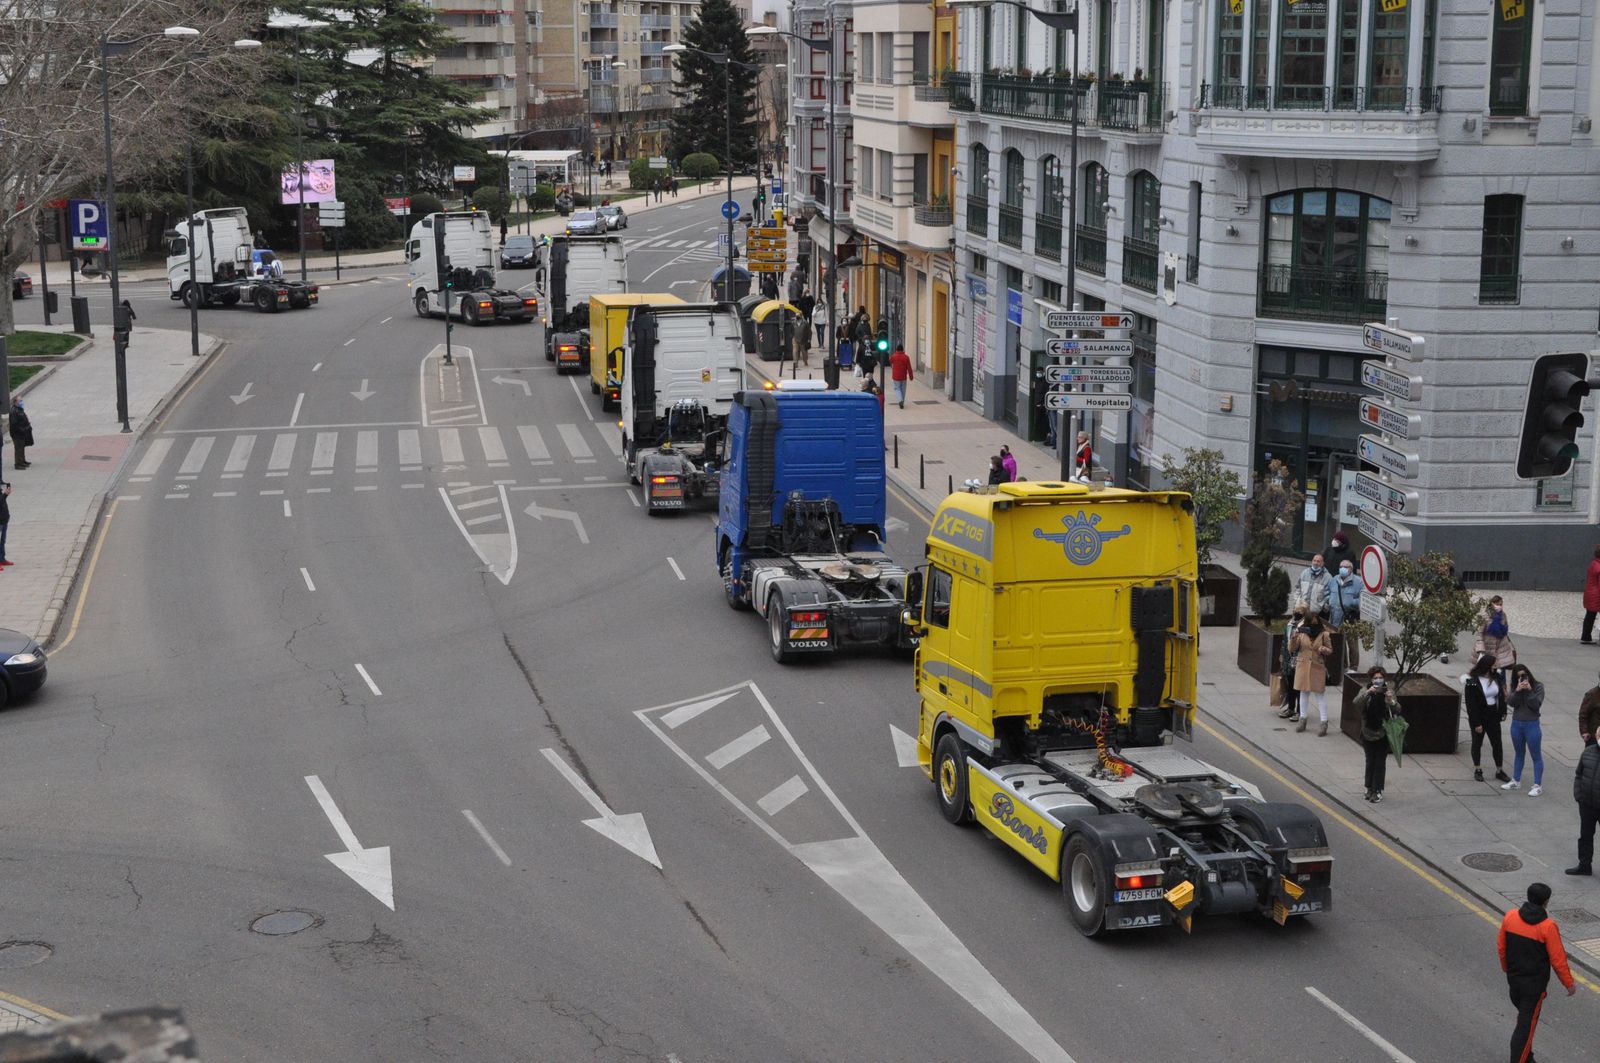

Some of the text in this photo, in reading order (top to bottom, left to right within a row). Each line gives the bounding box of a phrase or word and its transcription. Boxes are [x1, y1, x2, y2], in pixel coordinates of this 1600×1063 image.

[78, 203, 100, 234] P
[1083, 344, 1131, 352] SALAMANCA
[1383, 337, 1411, 353] SALAMANCA
[1384, 372, 1409, 387] TORDESILLAS
[1383, 381, 1409, 397] VALLADOLID
[1086, 398, 1129, 407] Hospitales
[1379, 409, 1408, 427] FUENTESAUCO
[1381, 418, 1408, 436] FERMOSELLE
[1382, 454, 1406, 471] Hospitales
[1060, 510, 1102, 528] DAF
[936, 513, 985, 542] XF 105
[789, 640, 828, 648] VOLVO
[1120, 890, 1143, 901] 4759
[1118, 914, 1161, 927] DAF
